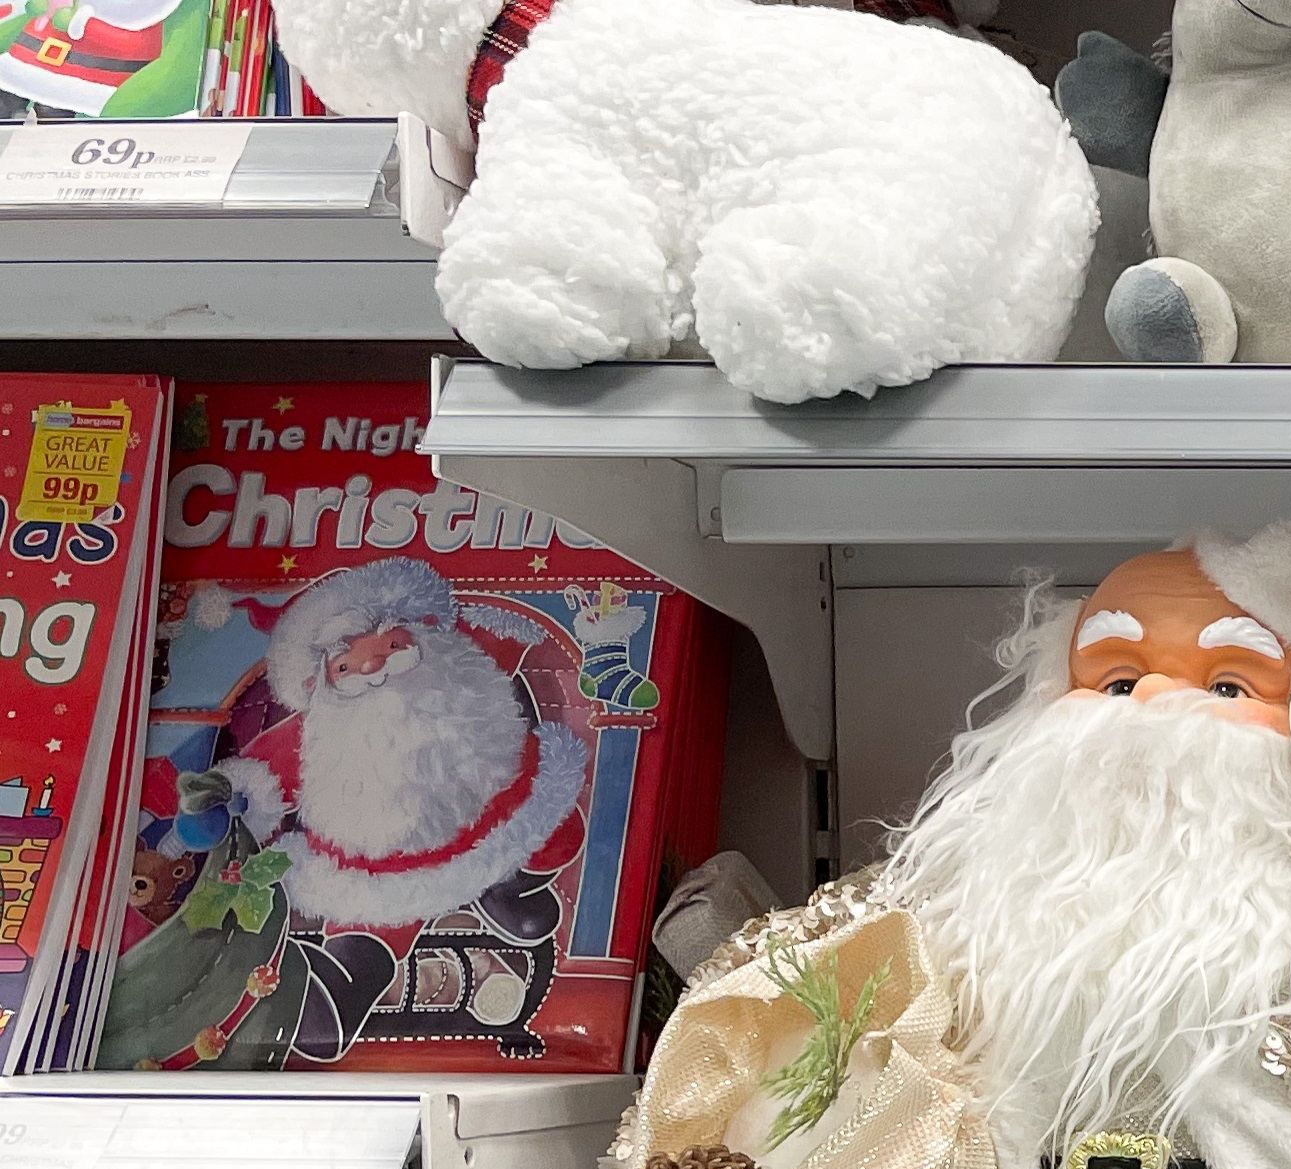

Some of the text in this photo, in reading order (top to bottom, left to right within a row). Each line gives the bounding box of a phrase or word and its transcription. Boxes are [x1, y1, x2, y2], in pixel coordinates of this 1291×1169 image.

[71, 138, 156, 169] 69p
[46, 435, 113, 454] GREAT
[222, 417, 305, 452] The
[44, 453, 110, 472] VALUE
[43, 477, 99, 506] 99p
